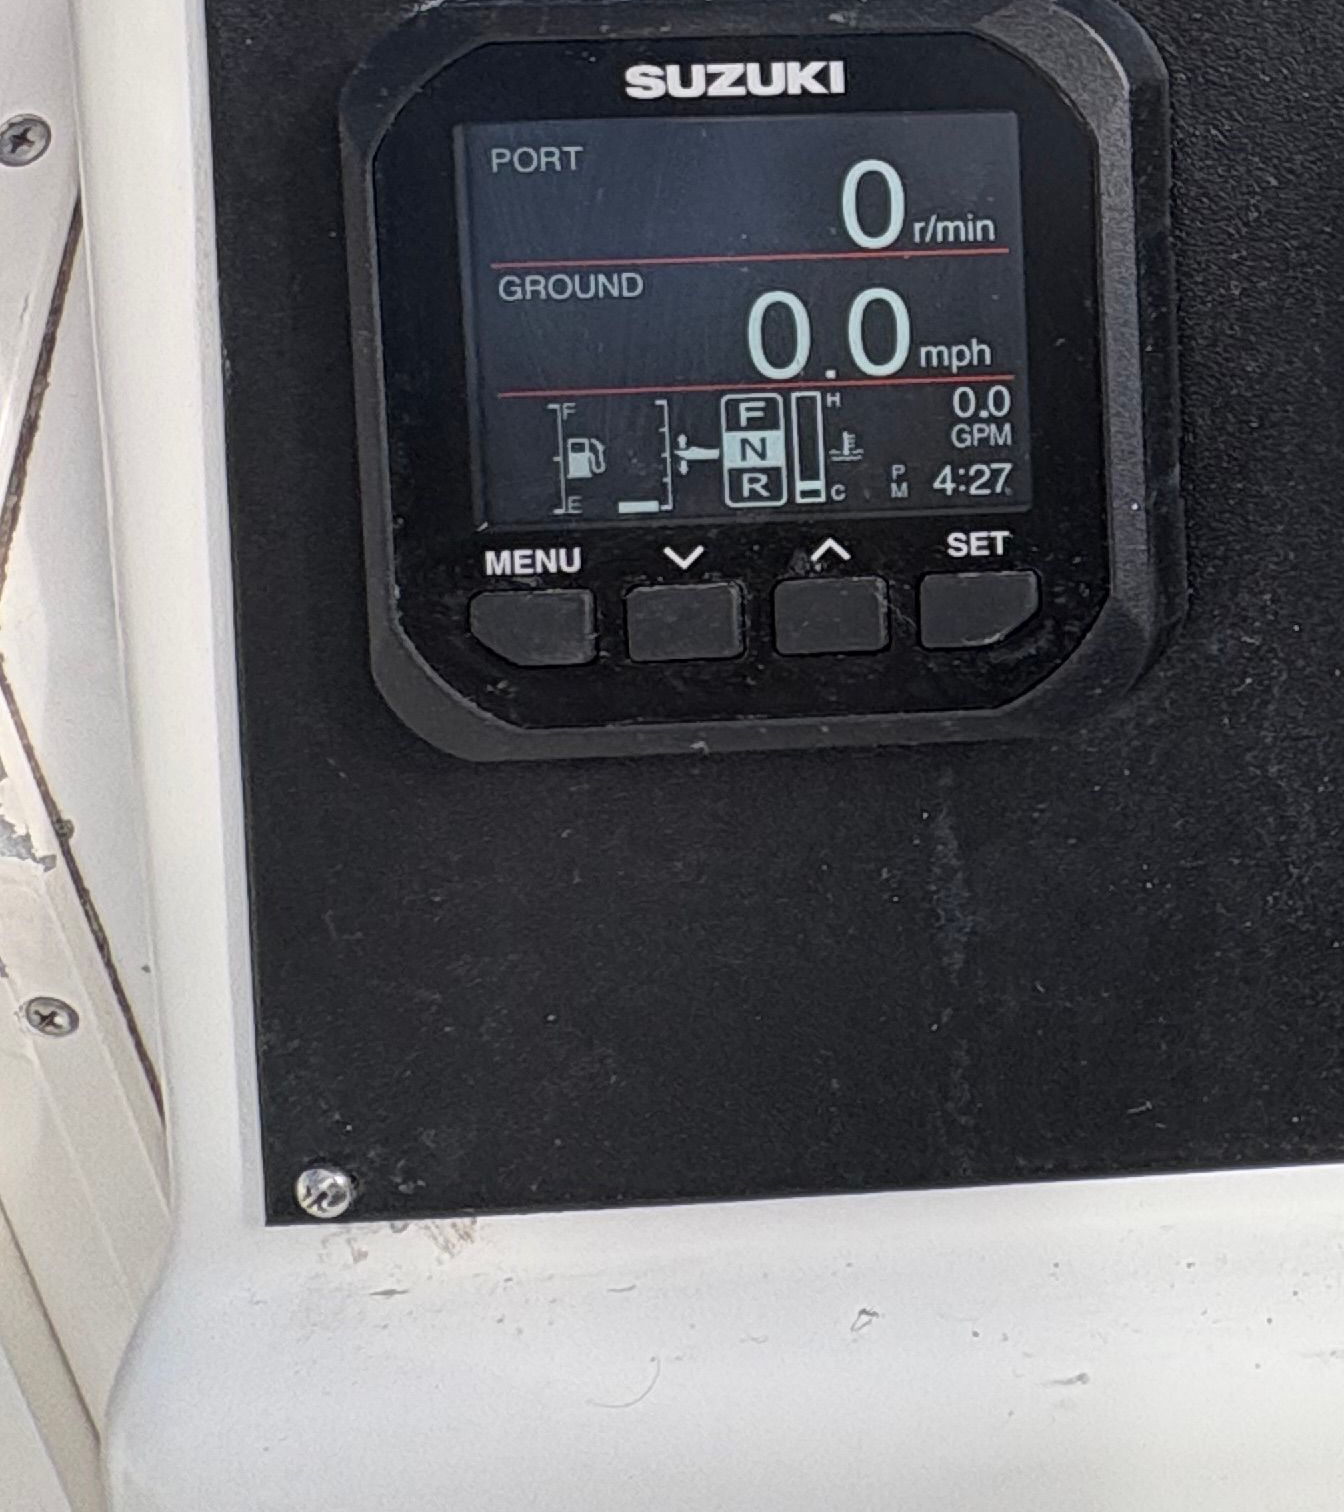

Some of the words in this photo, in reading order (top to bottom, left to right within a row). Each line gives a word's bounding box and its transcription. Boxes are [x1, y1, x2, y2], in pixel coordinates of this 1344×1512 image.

[625, 61, 847, 99] SUZUKI
[491, 146, 584, 174] PORT
[842, 159, 907, 250] 0
[913, 214, 996, 245] r/min
[498, 272, 644, 303] GROUND
[747, 287, 911, 380] 0.0
[919, 338, 992, 369] mph
[562, 402, 576, 421] F
[826, 392, 841, 408] H
[953, 385, 1011, 418] 0.0
[739, 402, 766, 427] F
[951, 422, 1012, 449] GPM
[739, 437, 768, 462] N
[742, 473, 770, 498] R
[830, 483, 847, 502] C
[932, 462, 1013, 497] 4:27
[568, 496, 583, 514] E
[946, 531, 1010, 557] SET
[484, 547, 582, 576] MENU
